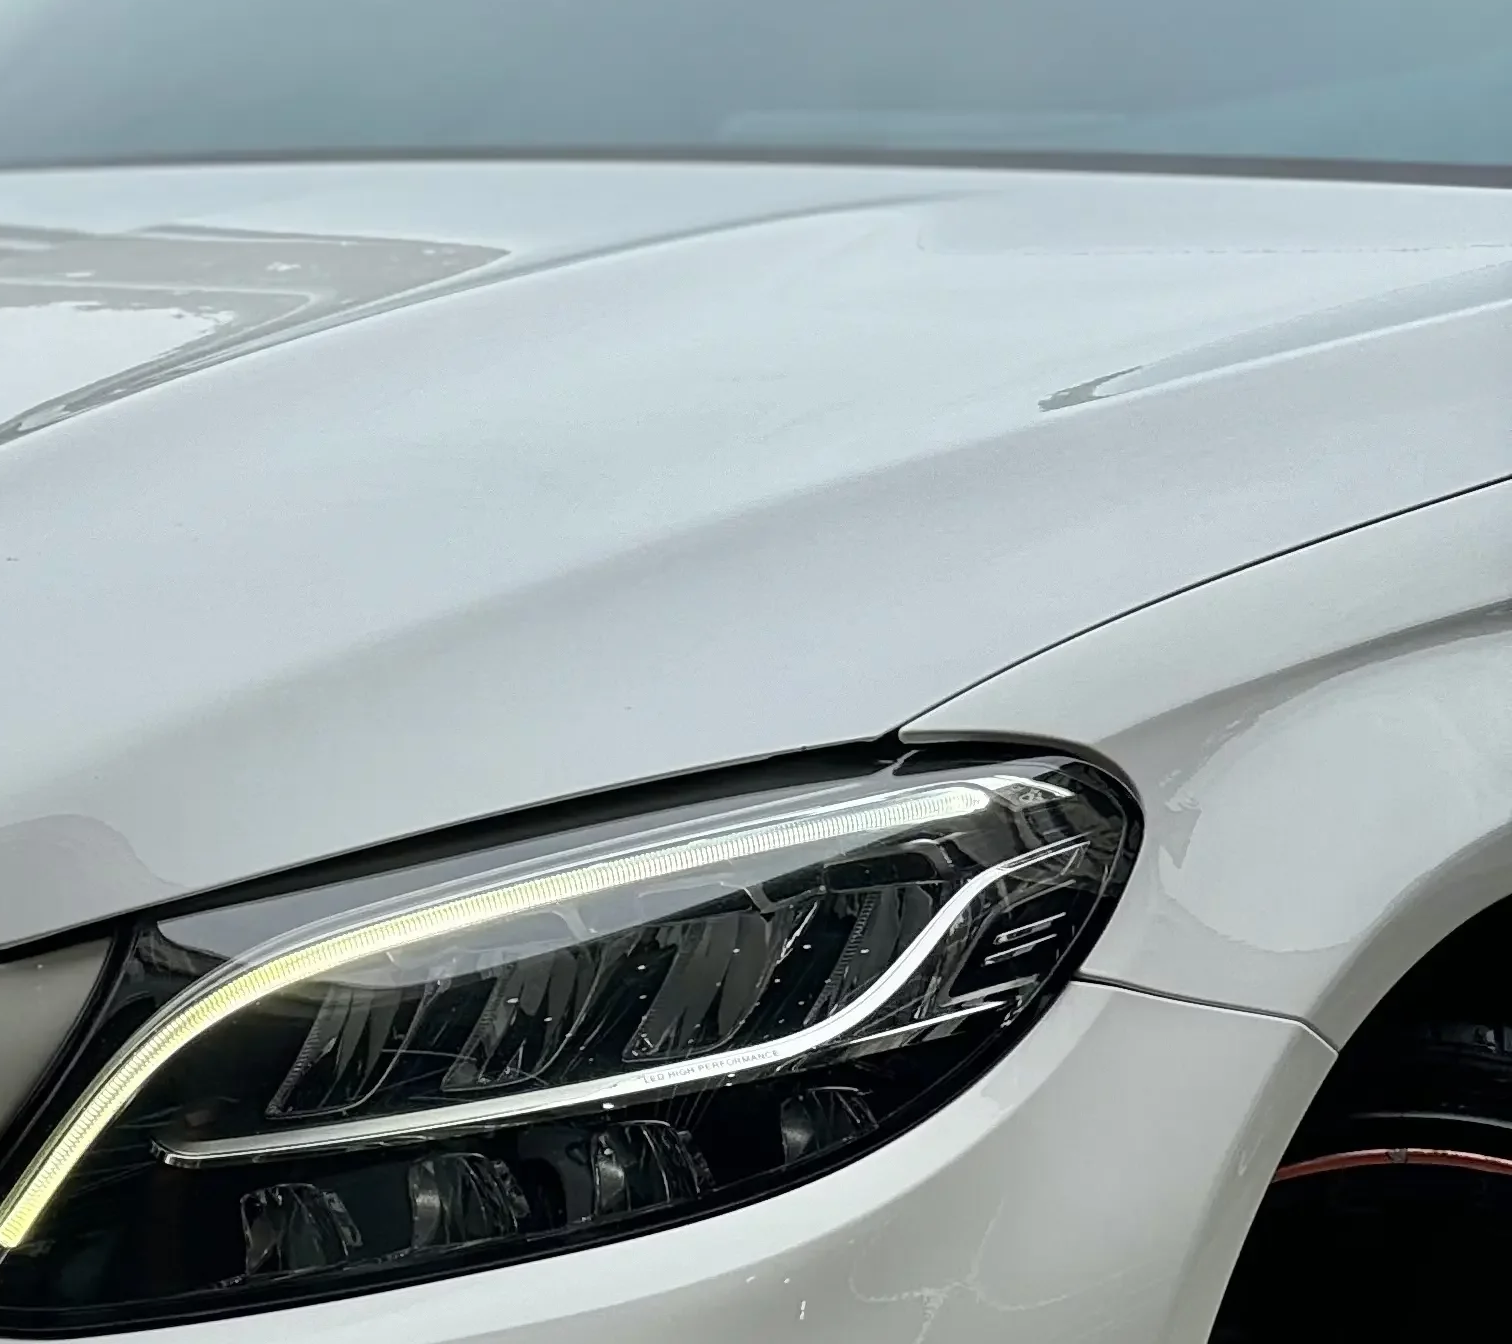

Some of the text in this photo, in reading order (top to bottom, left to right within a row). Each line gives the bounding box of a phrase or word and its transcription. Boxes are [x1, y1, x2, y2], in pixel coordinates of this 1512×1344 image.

[643, 1049, 780, 1084] LED HIGH PERFORMANCE
